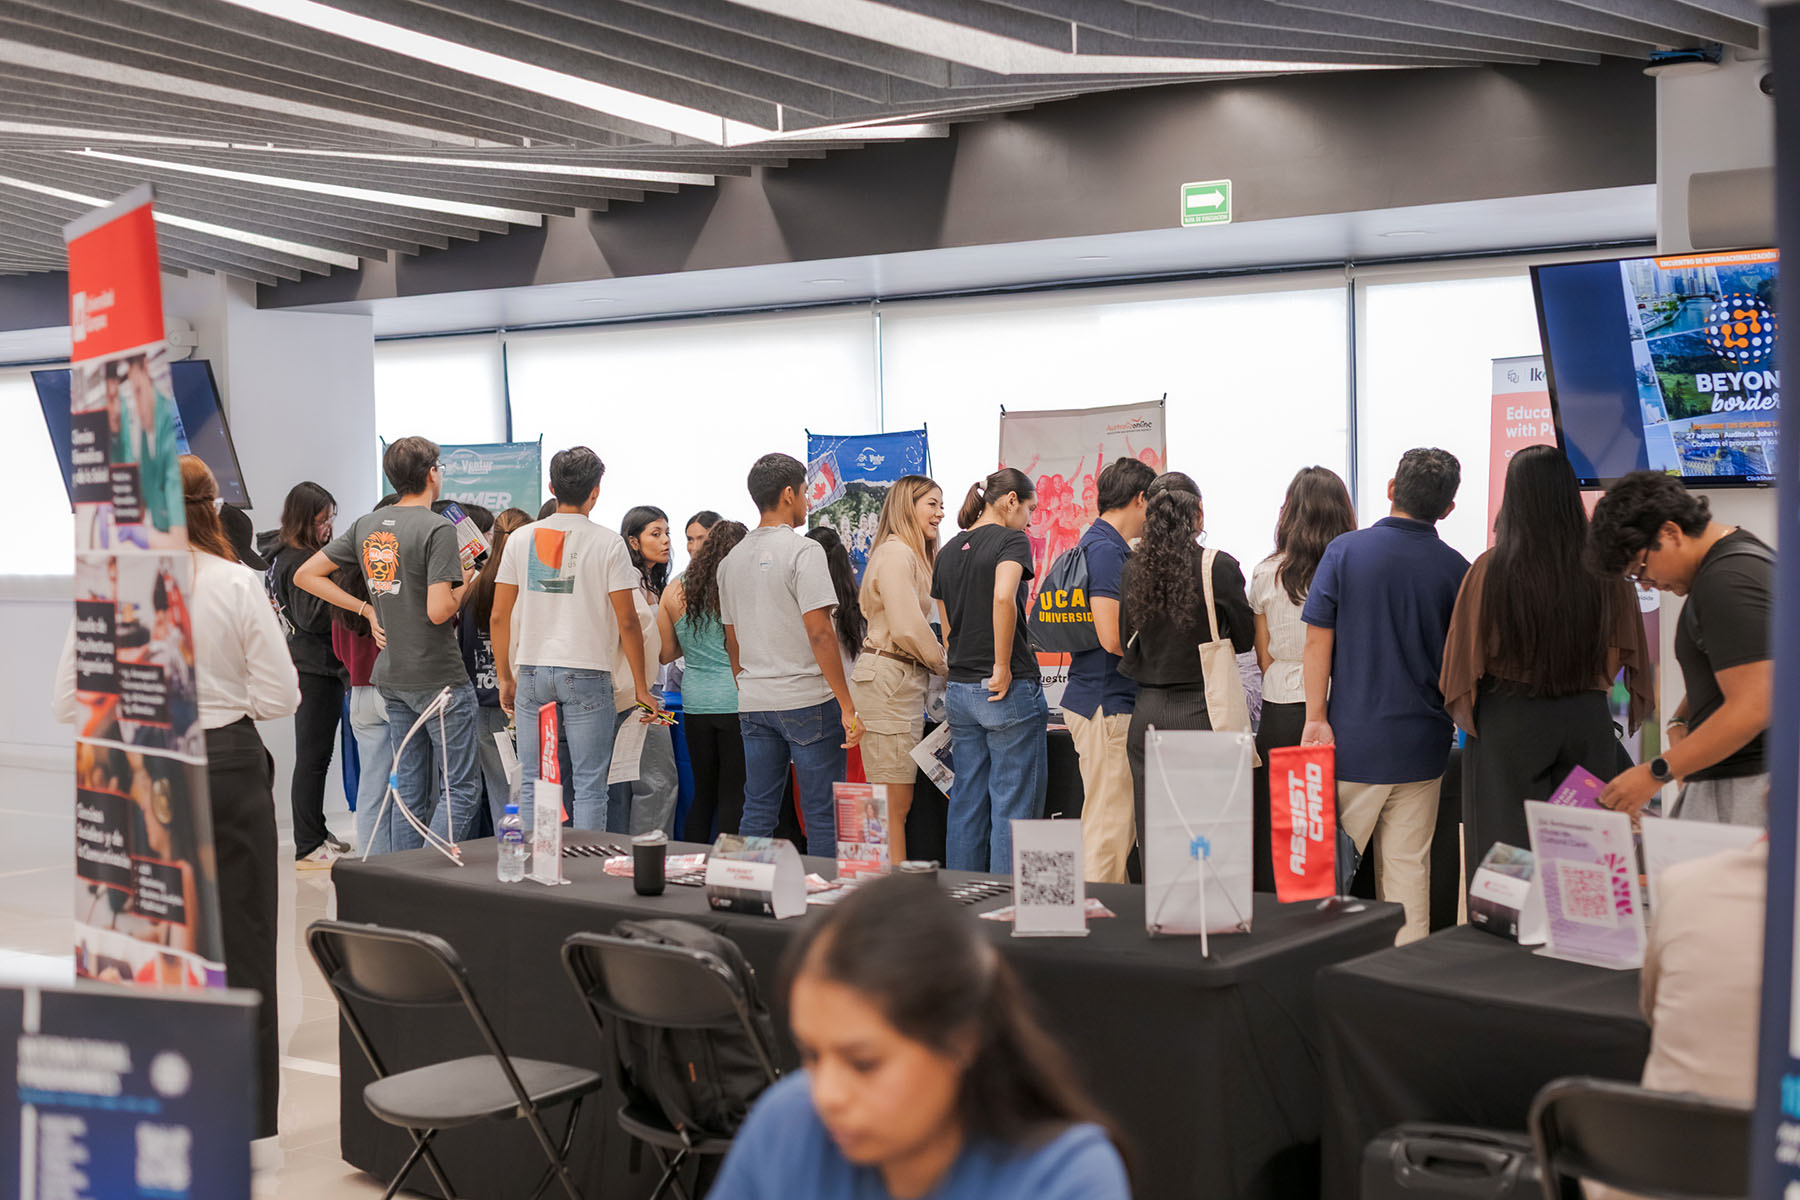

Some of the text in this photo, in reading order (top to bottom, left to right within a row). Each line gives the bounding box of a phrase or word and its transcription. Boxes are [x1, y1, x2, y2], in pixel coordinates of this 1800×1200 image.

[1530, 367, 1546, 382] Ik
[1695, 370, 1780, 393] BEYON
[1711, 391, 1780, 412] border
[1506, 406, 1551, 421] Educa
[1505, 422, 1556, 438] with Pu
[1724, 430, 1755, 439] Auditorio
[1039, 588, 1086, 611] UCA
[1039, 611, 1094, 623] UNIVERSID
[476, 672, 500, 689] TO
[1305, 762, 1324, 842] CARD
[1288, 769, 1308, 876] ASSIST
